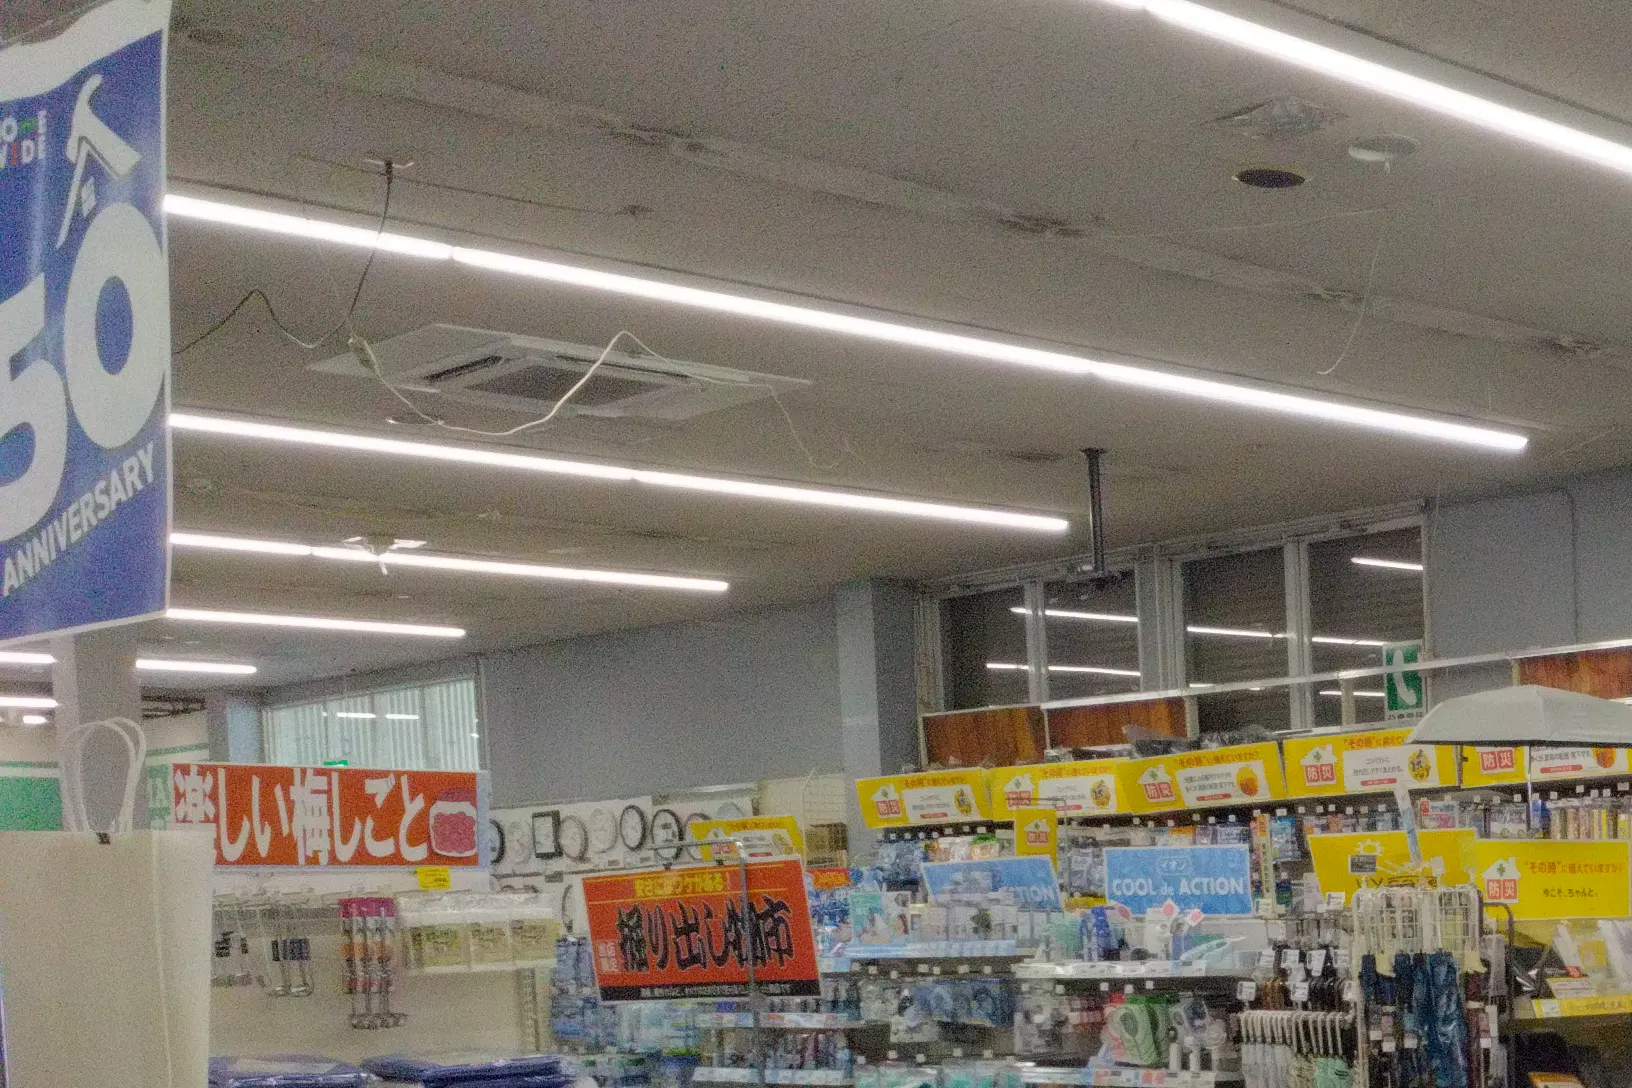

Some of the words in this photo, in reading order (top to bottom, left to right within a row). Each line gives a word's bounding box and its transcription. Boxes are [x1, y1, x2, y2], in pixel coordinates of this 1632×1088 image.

[3, 441, 154, 597] ANNIVERSARY
[1480, 750, 1515, 772] 防災
[1304, 763, 1335, 783] 防災
[174, 765, 430, 864] 楽しい梅しごと
[1112, 877, 1157, 896] COOL
[1179, 876, 1245, 896] ACTION
[1486, 879, 1518, 900] 防災
